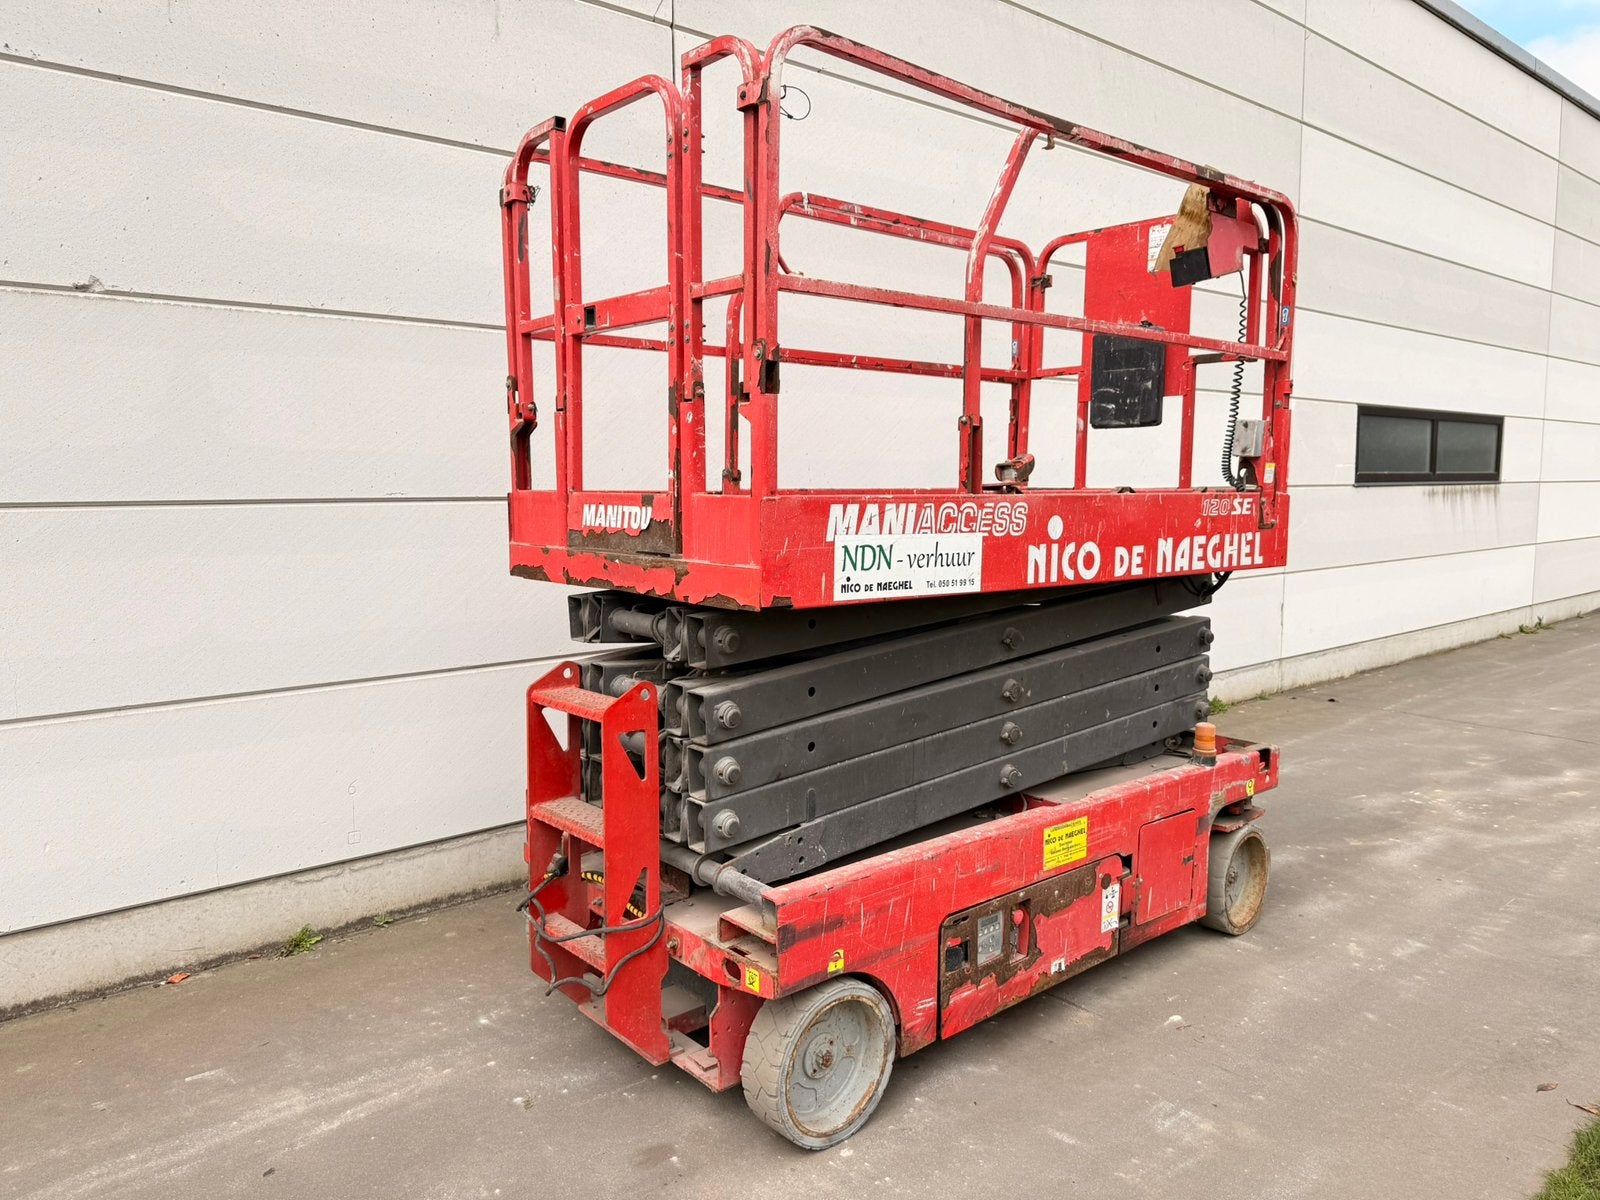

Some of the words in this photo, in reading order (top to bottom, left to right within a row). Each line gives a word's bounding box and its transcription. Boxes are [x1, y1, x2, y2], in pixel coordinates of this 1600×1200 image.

[582, 504, 652, 530] MANITOU
[825, 501, 1029, 542] MANIACCESS
[1114, 545, 1144, 577] DE
[1156, 531, 1264, 573] NAEGHEL
[864, 583, 874, 592] DE
[876, 580, 913, 592] NAEGHEL
[938, 579, 950, 588] 050
[951, 579, 958, 587] 51
[959, 578, 967, 587] 99
[968, 578, 975, 586] 15
